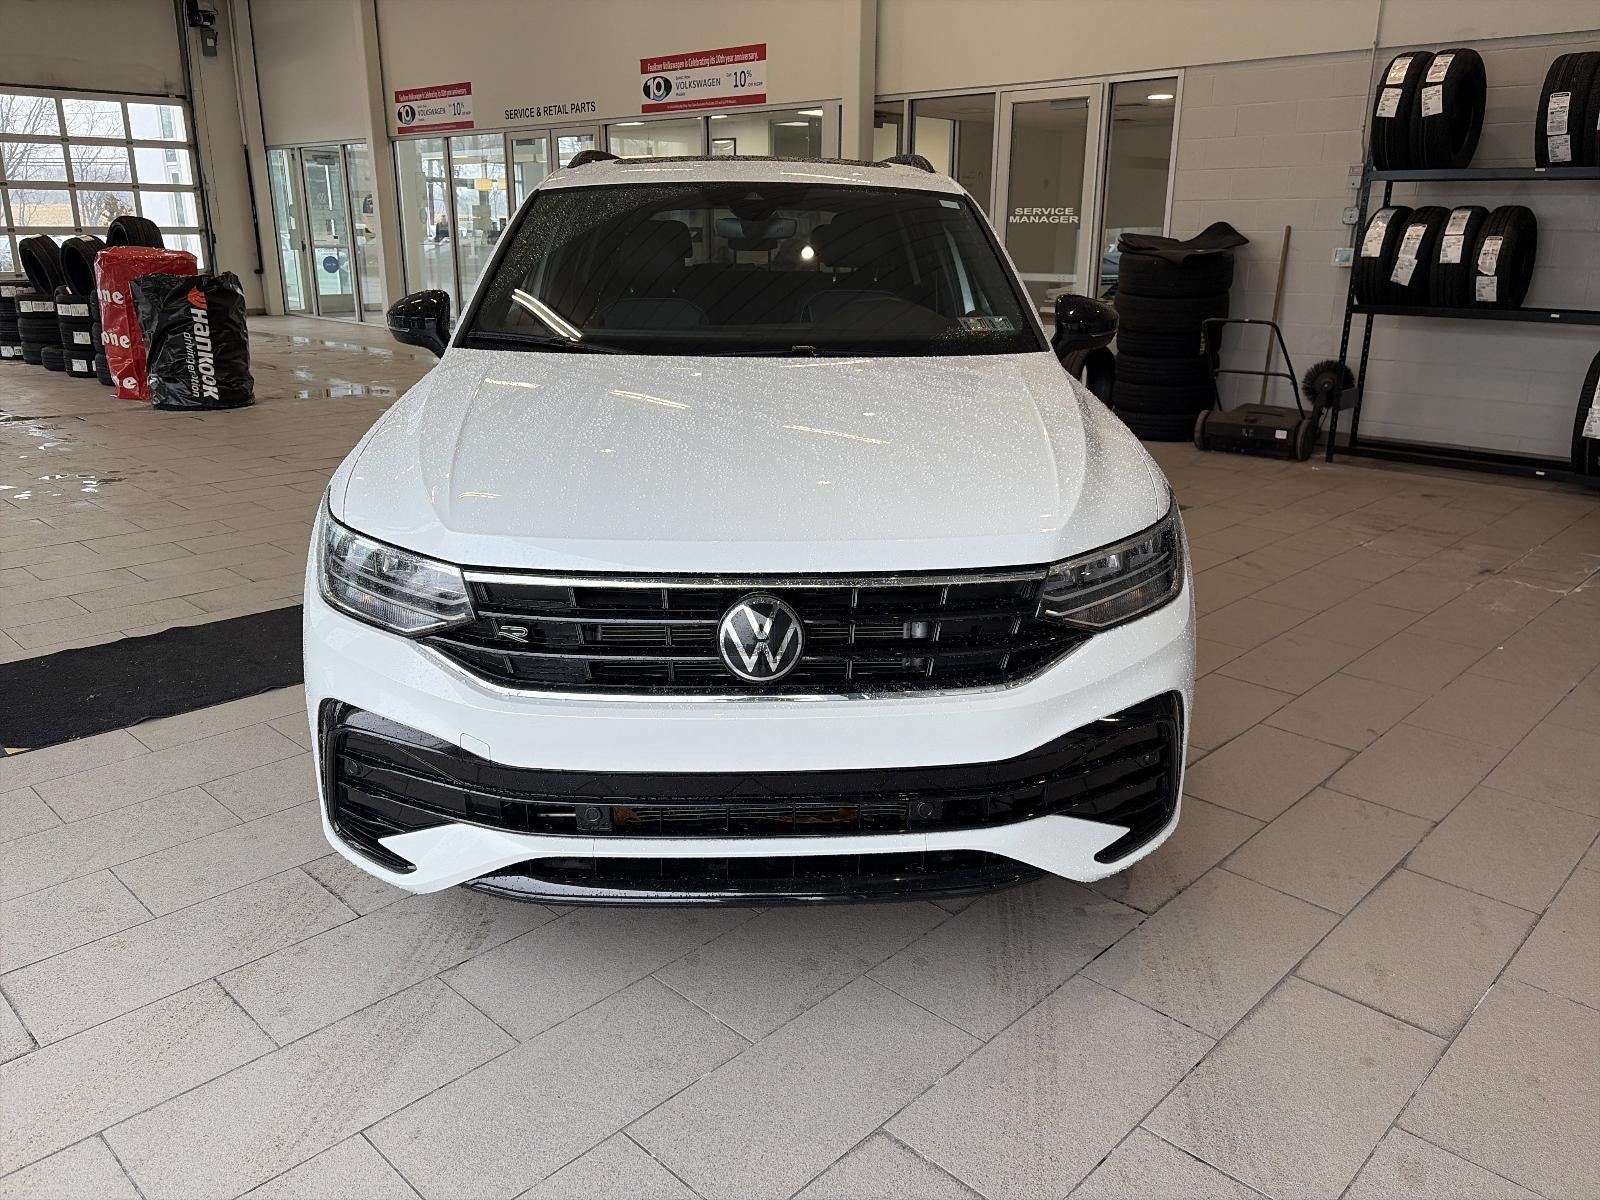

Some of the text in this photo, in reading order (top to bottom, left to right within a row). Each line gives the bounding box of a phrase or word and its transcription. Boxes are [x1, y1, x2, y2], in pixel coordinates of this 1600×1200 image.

[647, 77, 665, 100] 10
[675, 78, 720, 90] VOLKSWAGEN
[504, 101, 596, 120] SERVICE & RETAIL PARTS
[1014, 207, 1075, 216] SERVICE
[1009, 215, 1080, 224] MANAGER
[184, 331, 196, 365] driving
